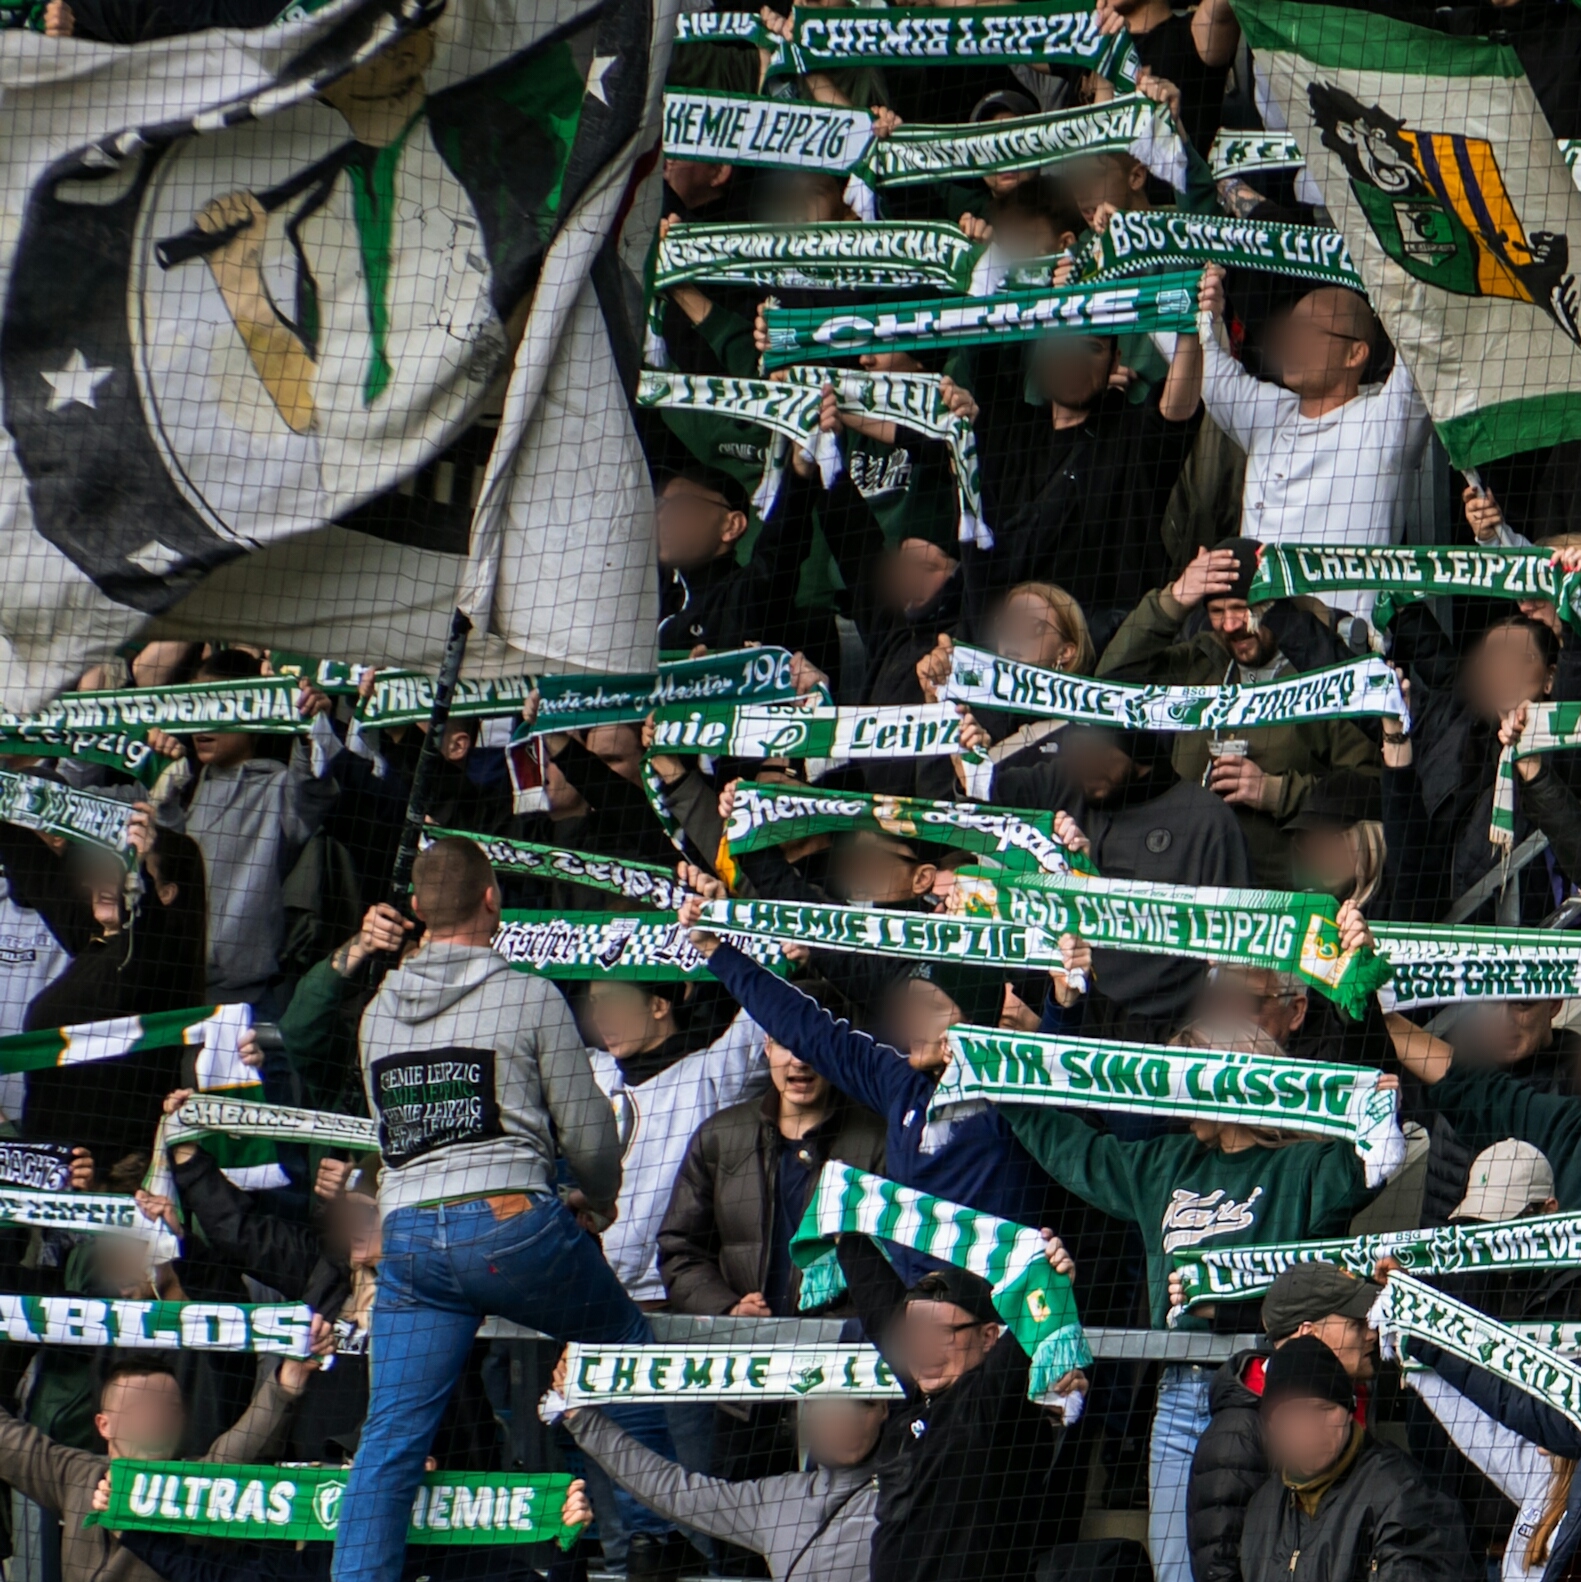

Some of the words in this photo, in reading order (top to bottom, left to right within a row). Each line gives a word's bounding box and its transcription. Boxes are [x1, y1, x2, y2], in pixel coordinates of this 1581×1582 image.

[801, 17, 949, 57] CHEMIE
[664, 102, 750, 148] HEMIE
[749, 108, 854, 158] LEIPZIG
[1110, 211, 1167, 257] BSG
[1167, 218, 1273, 257] CHEMIE
[812, 288, 1140, 349] CHEMIE
[1302, 547, 1422, 584] CHEMIE
[1431, 549, 1558, 592] LEIPZIG
[536, 686, 632, 717] eutscher
[736, 652, 794, 697] 196
[990, 660, 1120, 717] CHEMIE
[851, 714, 960, 751] Leipz
[879, 918, 1030, 962] LEIPZIG
[1009, 886, 1069, 932] BSG
[1079, 890, 1181, 943] CHEMIE
[1189, 902, 1294, 957] LEIPZIG
[1462, 957, 1579, 996] CHEMIE
[426, 1062, 481, 1086] LEIPZIG
[961, 1036, 1053, 1085] WIR
[1067, 1050, 1172, 1101] SIND
[1184, 1055, 1357, 1118] LÄSSIG
[423, 1096, 481, 1119] LEIPZIG
[0, 1296, 313, 1357] ABLOS
[576, 1355, 771, 1391] CHEMIE
[128, 1473, 294, 1527] ULTRAS
[409, 1483, 535, 1532] HEMIE
